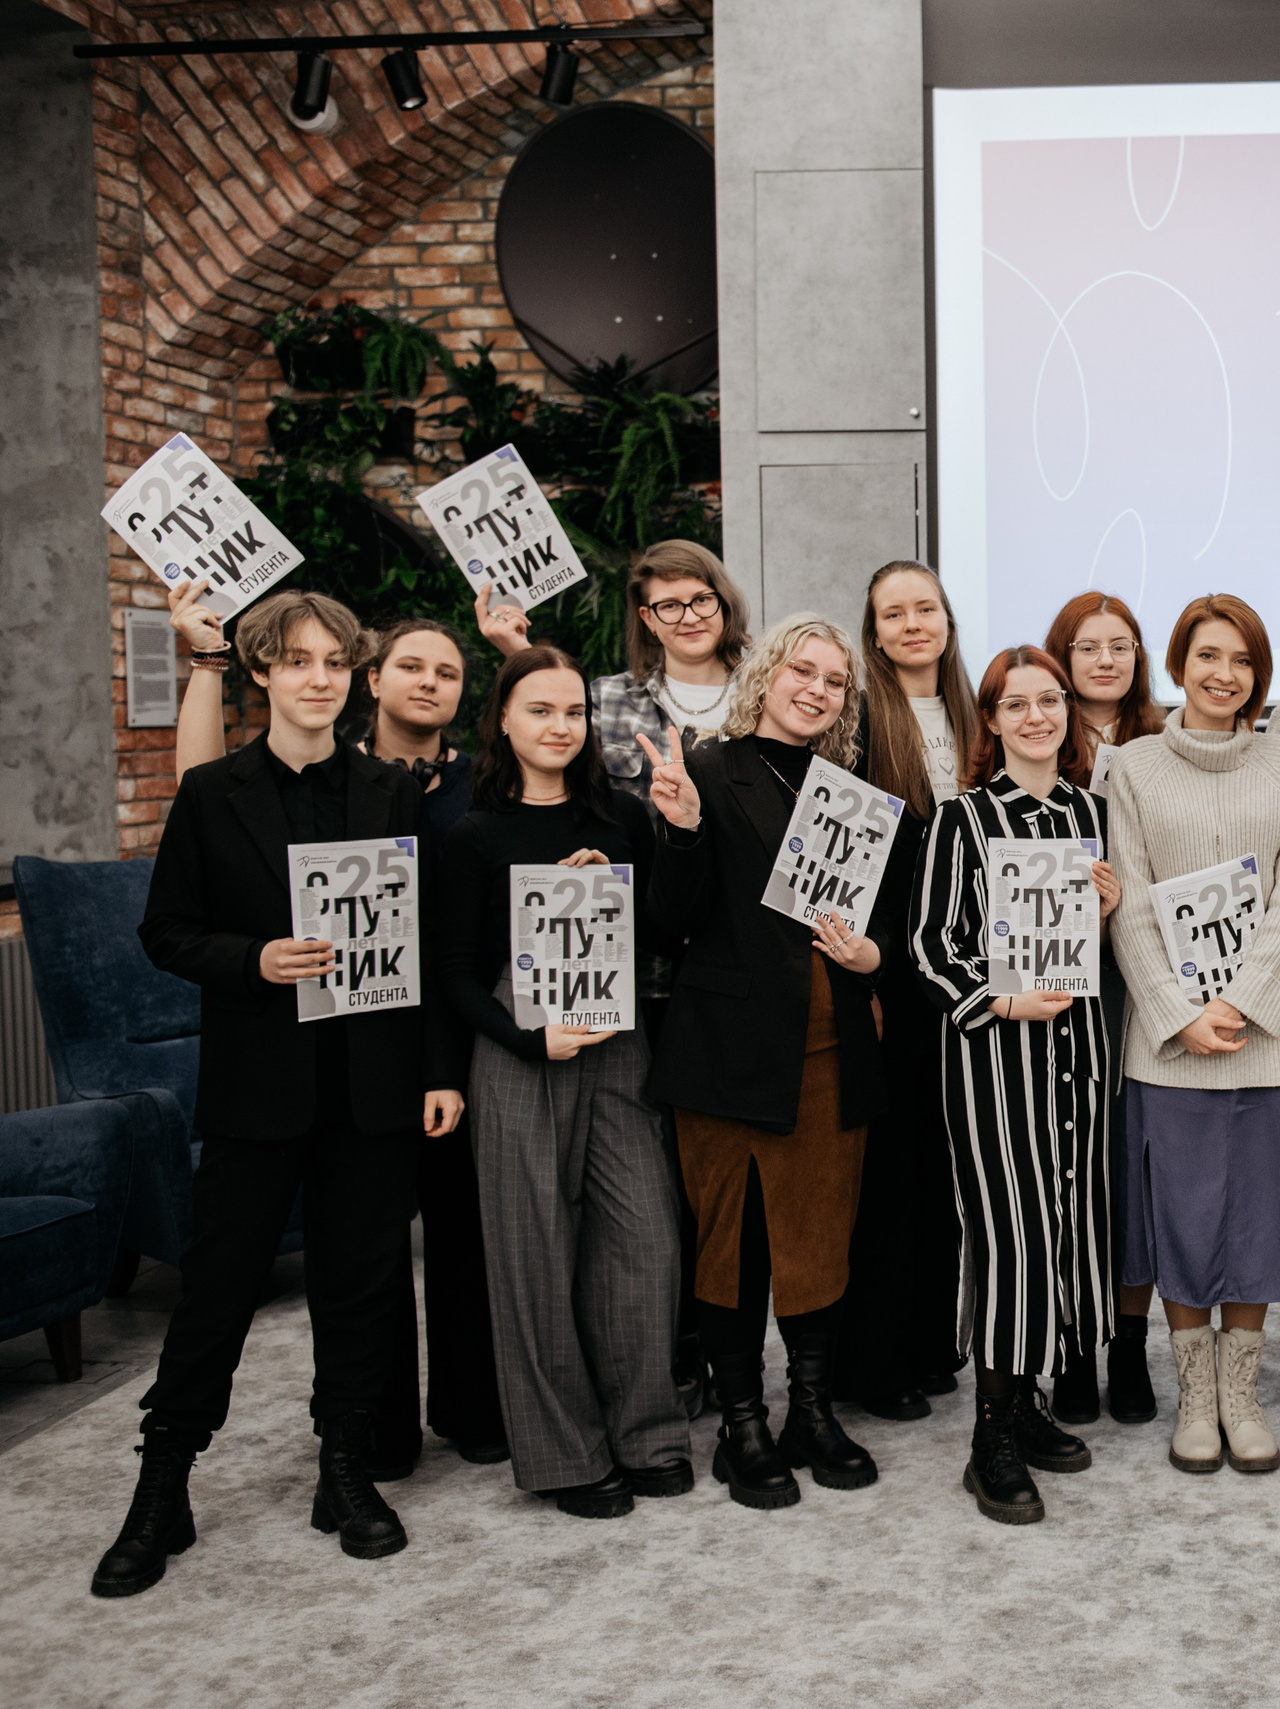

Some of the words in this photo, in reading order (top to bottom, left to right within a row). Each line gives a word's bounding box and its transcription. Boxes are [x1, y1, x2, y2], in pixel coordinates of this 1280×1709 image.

[139, 446, 210, 522] 25
[460, 457, 527, 520] 25
[200, 529, 224, 553] лет
[505, 538, 528, 558] лет
[239, 551, 289, 594] СТУДЕНТА
[528, 567, 575, 600] СТУДЕНТА
[833, 788, 889, 845] 25
[336, 848, 409, 903] 25
[819, 858, 845, 876] лет
[1026, 848, 1092, 896] 25
[552, 875, 624, 926] 25
[1198, 868, 1257, 926] 25
[347, 937, 377, 950] лет
[1033, 927, 1061, 938] лет
[561, 959, 591, 971] лет
[1221, 952, 1244, 969] лет
[349, 987, 408, 1006] СТУДЕНТА
[1034, 978, 1089, 991] СТУДЕНТА
[562, 1012, 621, 1026] СТУДЕНТА
